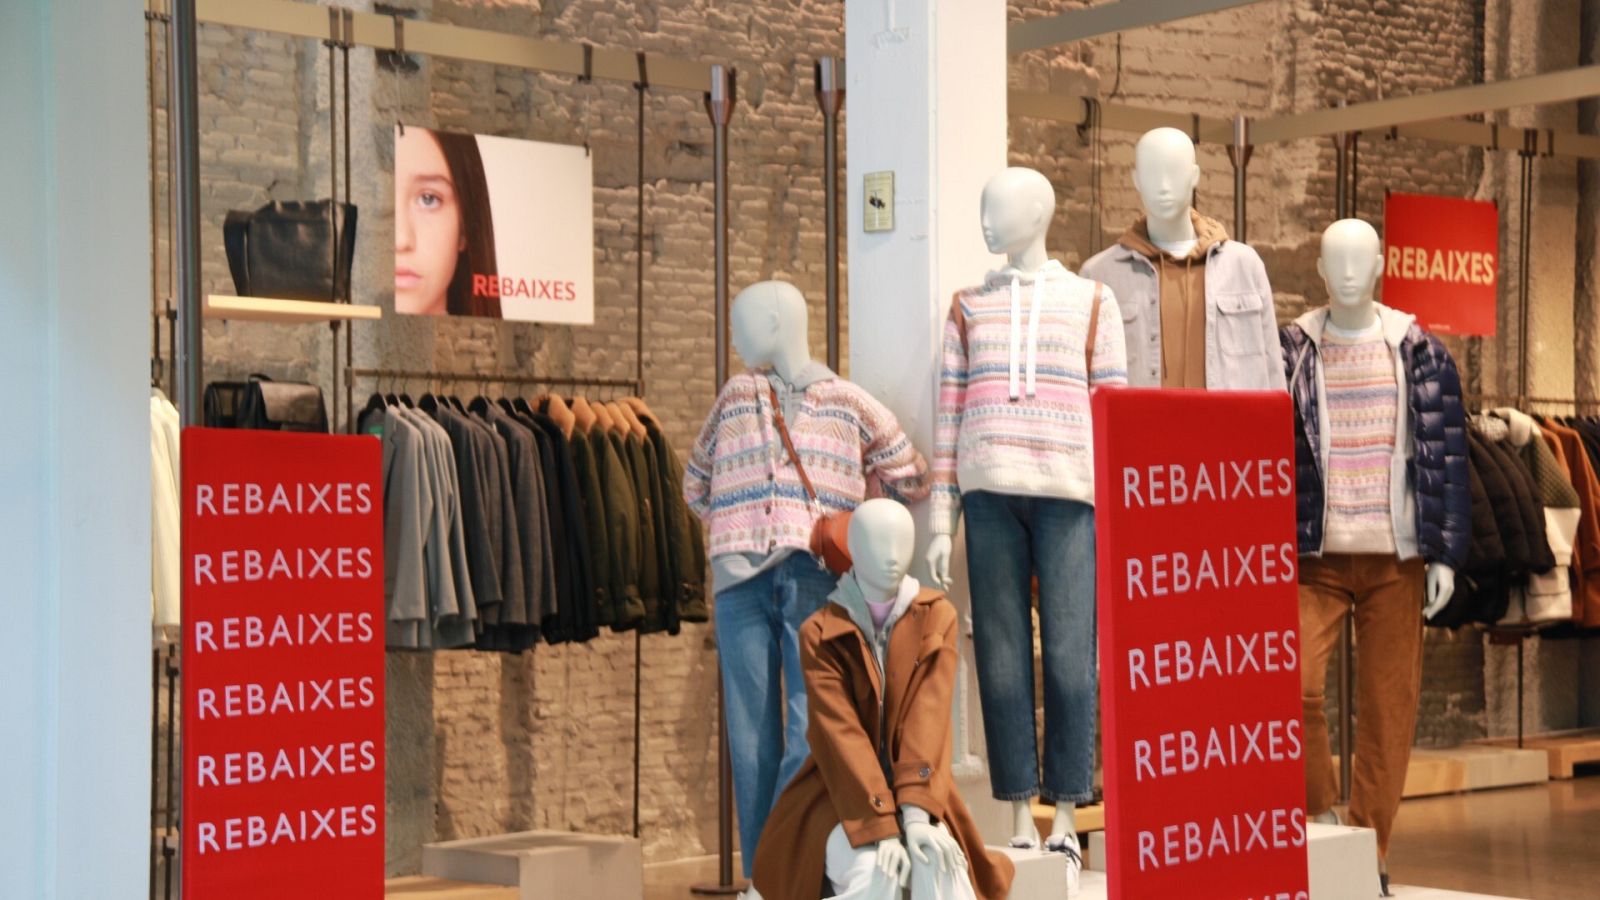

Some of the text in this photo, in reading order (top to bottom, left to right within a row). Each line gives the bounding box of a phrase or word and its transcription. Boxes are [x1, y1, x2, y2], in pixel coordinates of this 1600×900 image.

[472, 273, 577, 302] REBAIXES
[1386, 245, 1495, 287] REBAIXES
[196, 482, 372, 516] REBAIXES
[1122, 458, 1292, 509] REBAIXES
[194, 547, 373, 586] REBAIXES
[1126, 542, 1295, 601] REBAIXES
[195, 612, 373, 653] REBAIXES
[1127, 629, 1297, 691] REBAIXES
[197, 676, 375, 720] REBAIXES
[197, 740, 376, 788] REBAIXES
[1134, 718, 1302, 782] REBAIXES
[198, 804, 377, 855] REBAIXES
[1137, 807, 1306, 871] REBAIXES
